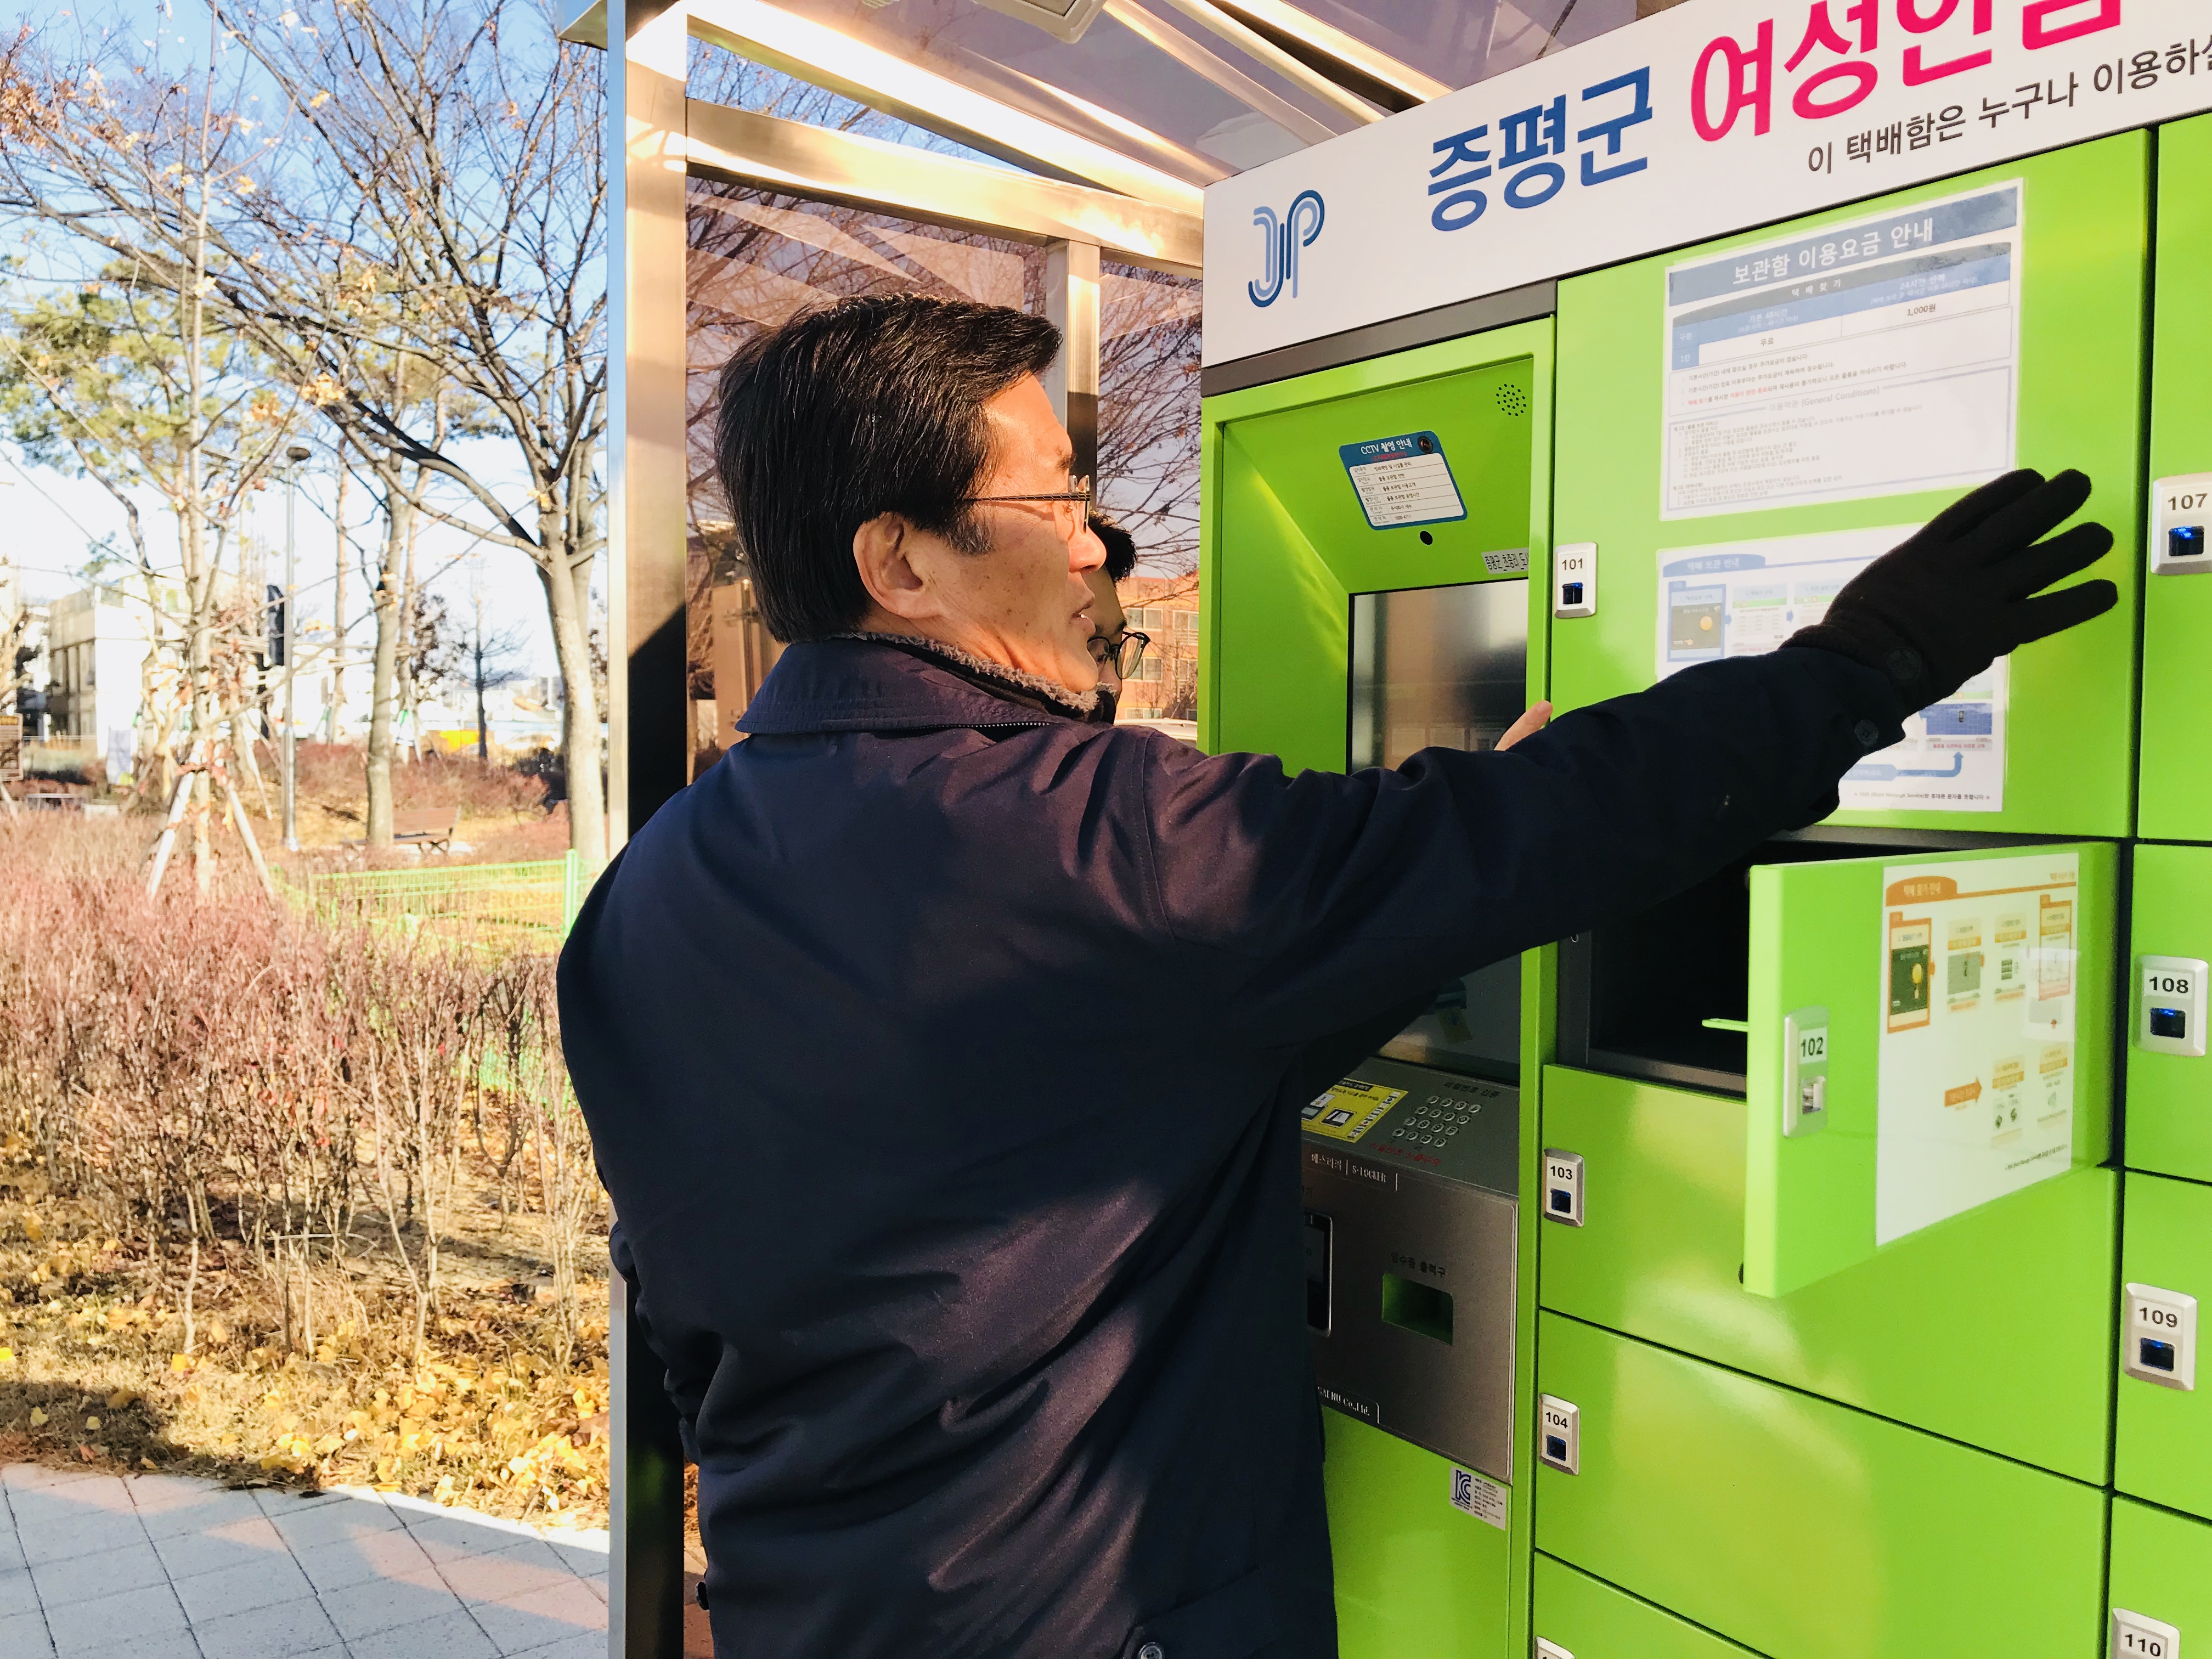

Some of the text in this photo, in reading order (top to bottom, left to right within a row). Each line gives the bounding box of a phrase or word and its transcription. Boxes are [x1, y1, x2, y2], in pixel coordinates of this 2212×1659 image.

[1809, 142, 1832, 173] 이
[1847, 104, 1965, 163] 택배함은
[1978, 72, 2079, 128] 누구나
[1428, 66, 1652, 232] 증평군
[1733, 217, 1933, 285] 보관함 이용요금 안내
[1908, 303, 1936, 316] 1,000원
[1760, 337, 1774, 346] 무료
[1769, 386, 1880, 411] 이용약관 [General Conditions]
[1361, 438, 1413, 454] CCTV 촬영 안내
[2168, 493, 2208, 511] 107
[1562, 558, 1583, 571] 101
[2149, 976, 2188, 994] 108
[1801, 1036, 1824, 1057] 102
[1550, 1165, 1573, 1180] 103
[2139, 1307, 2177, 1328] 109
[1546, 1412, 1568, 1429] 104
[2124, 1634, 2161, 1657] 110
